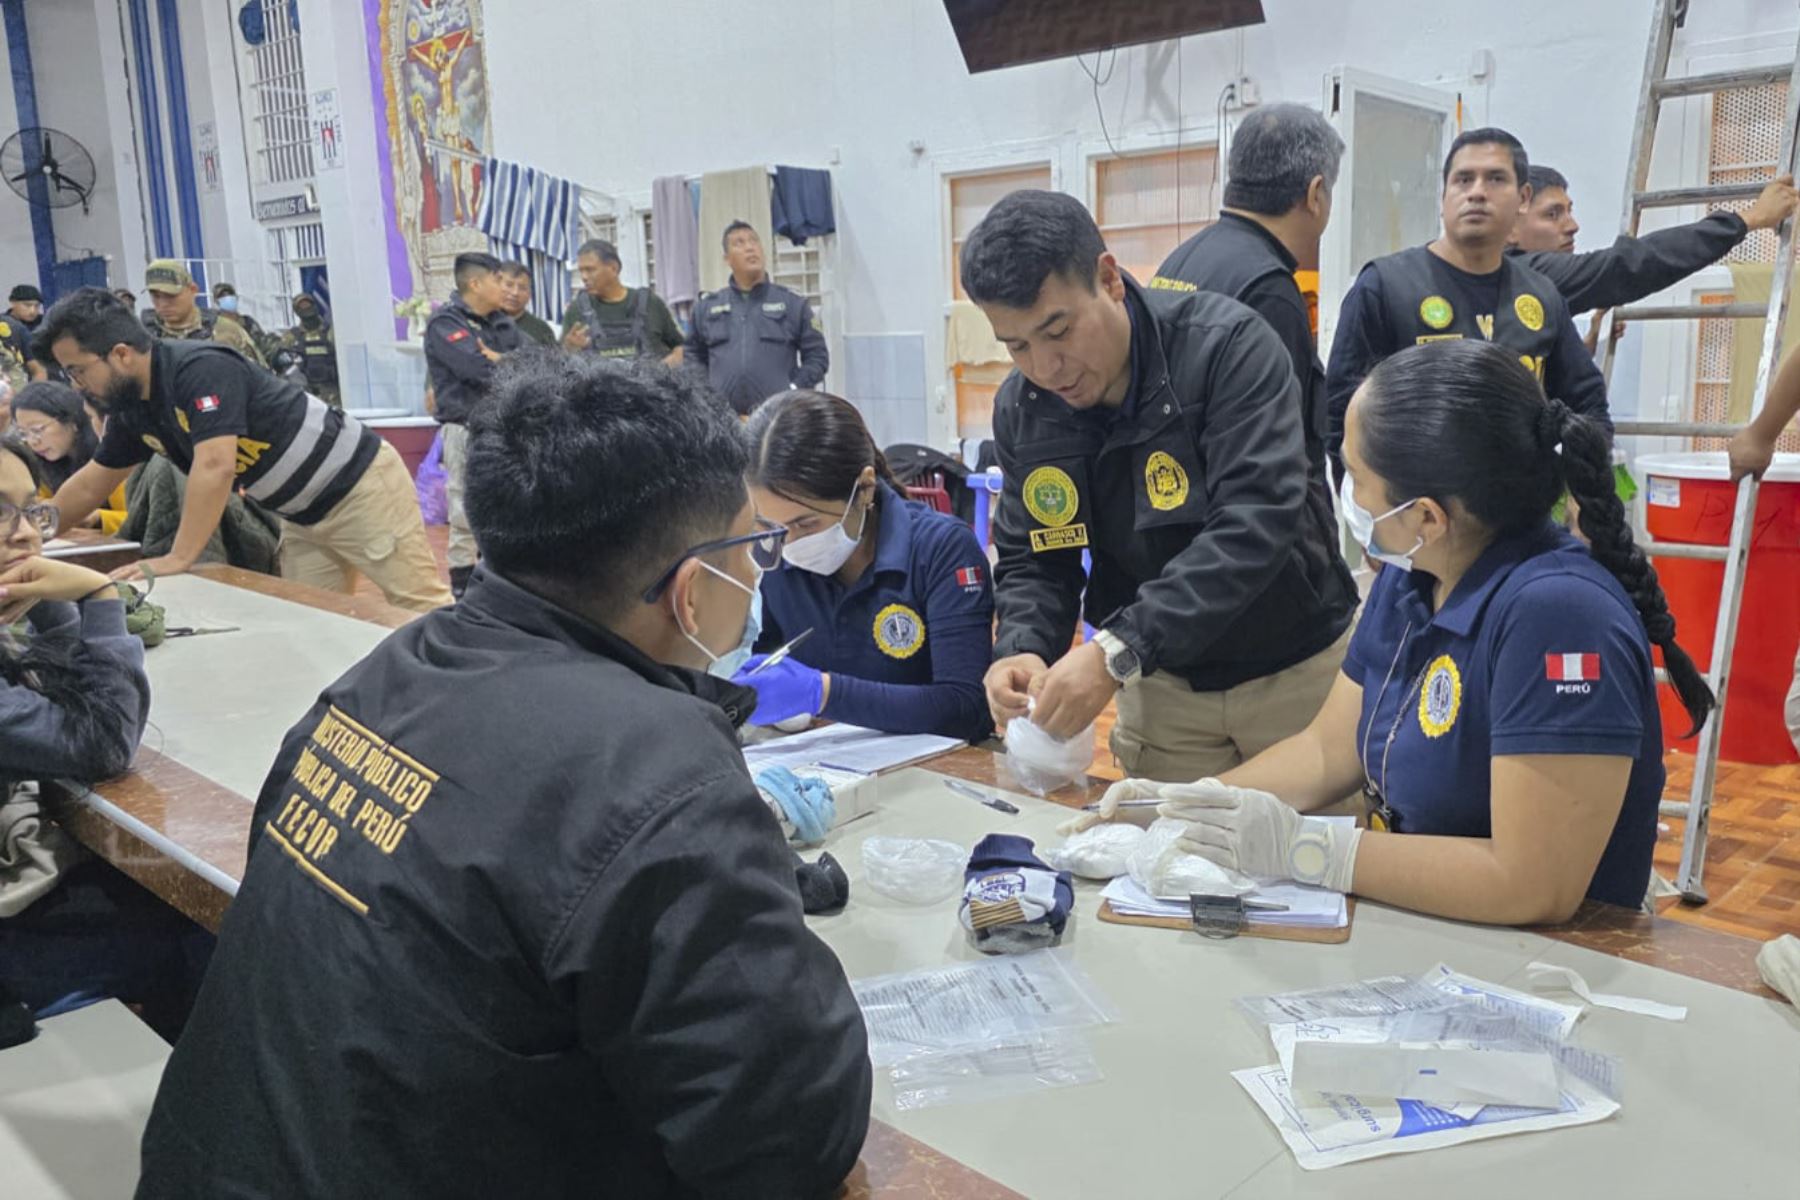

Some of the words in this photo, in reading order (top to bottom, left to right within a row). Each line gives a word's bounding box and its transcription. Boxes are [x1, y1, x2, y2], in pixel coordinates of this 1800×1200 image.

[1556, 682, 1591, 694] PERÚ
[357, 742, 434, 813] PÚBLICO
[276, 793, 340, 861] FECOR
[328, 780, 358, 820] DEL
[351, 799, 411, 856] PERÚ
